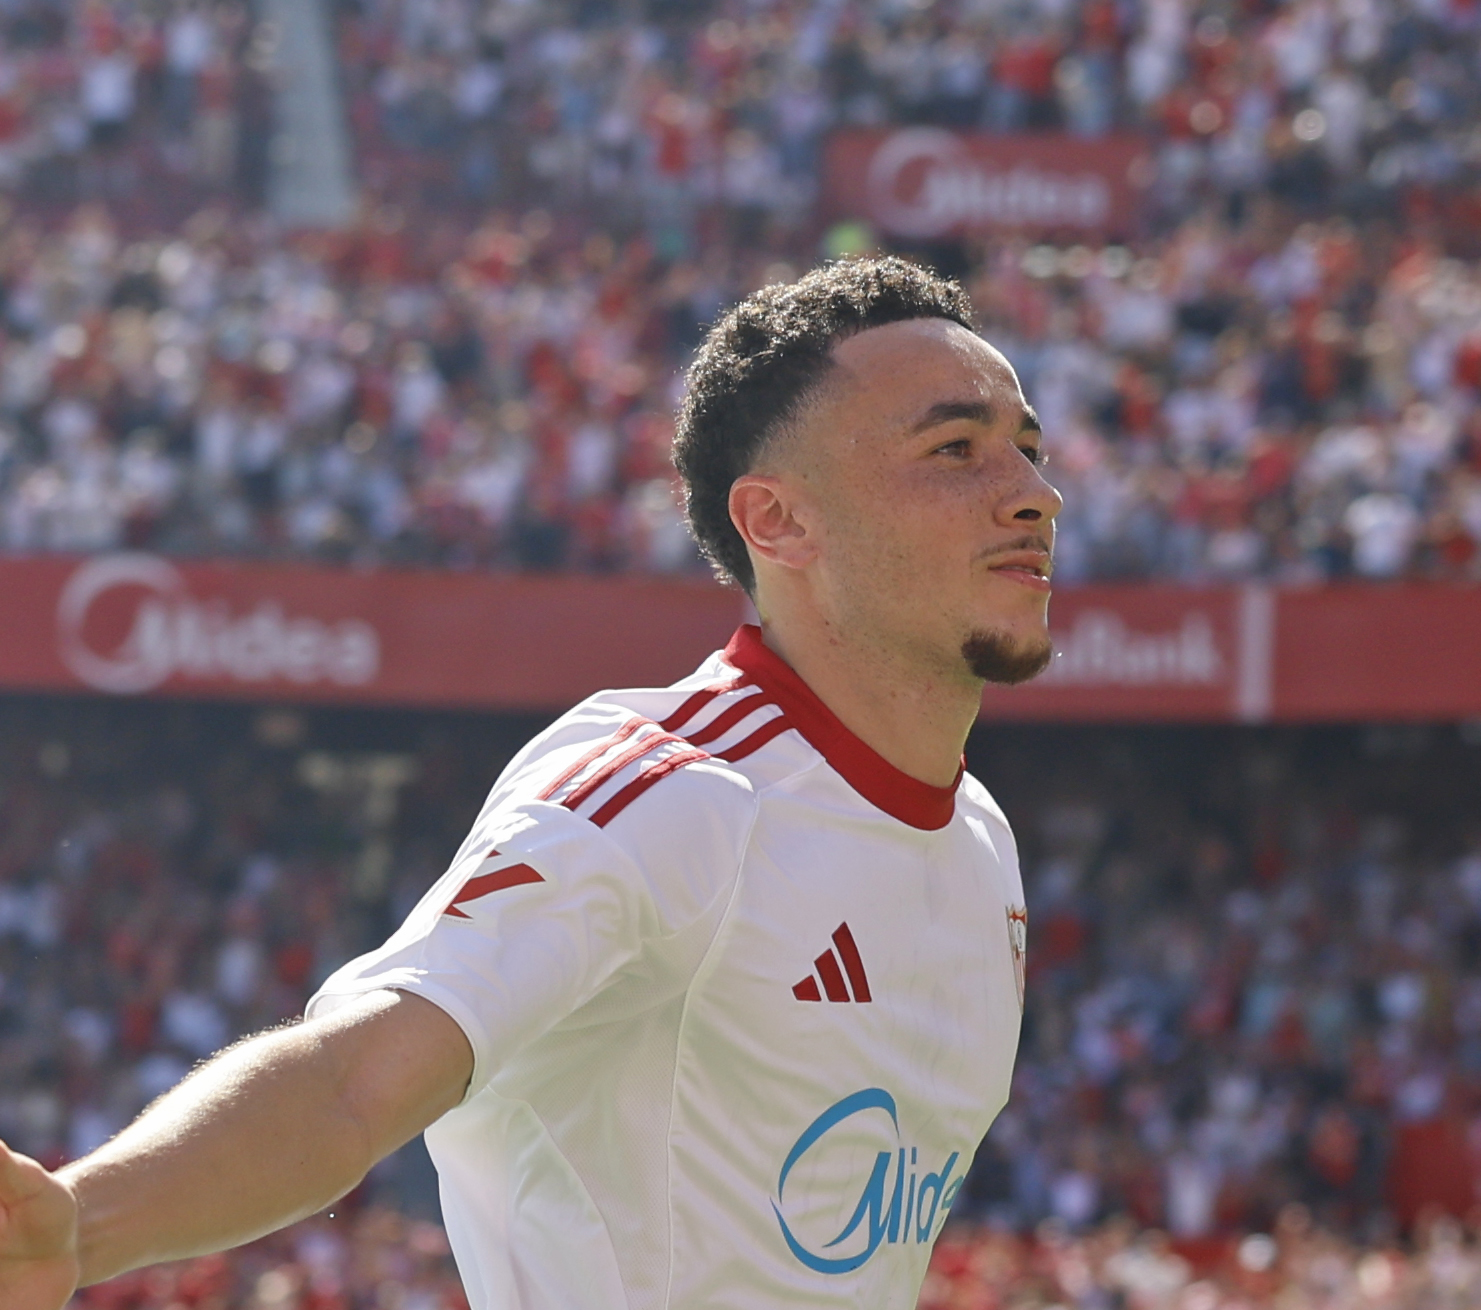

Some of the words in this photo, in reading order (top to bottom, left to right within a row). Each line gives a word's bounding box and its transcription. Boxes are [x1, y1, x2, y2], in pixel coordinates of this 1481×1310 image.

[60, 555, 378, 692] Midea
[1044, 613, 1222, 683] aBank
[770, 1087, 966, 1275] Mide
